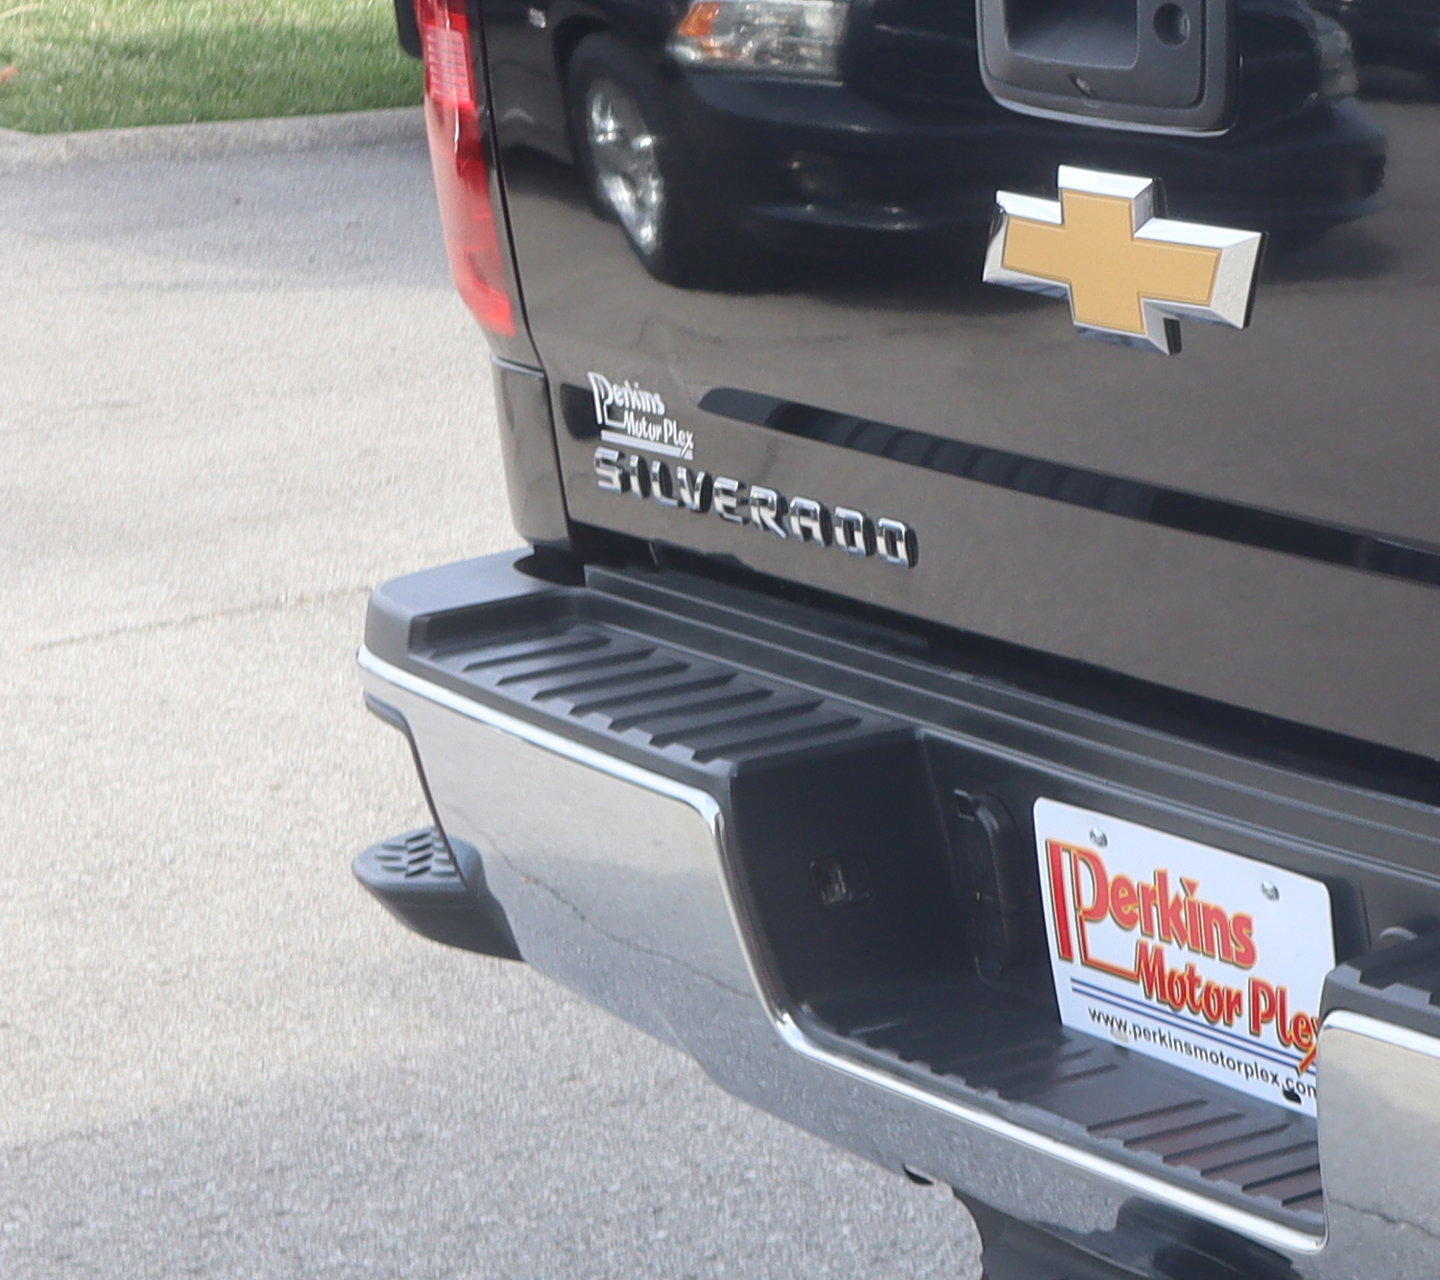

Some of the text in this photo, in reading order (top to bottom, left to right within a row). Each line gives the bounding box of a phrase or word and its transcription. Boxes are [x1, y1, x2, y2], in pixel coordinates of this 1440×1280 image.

[587, 371, 666, 425] Perkins
[594, 446, 913, 570] SILVERADO
[1046, 838, 1258, 970] Perkins
[1135, 939, 1243, 1026] Motor
